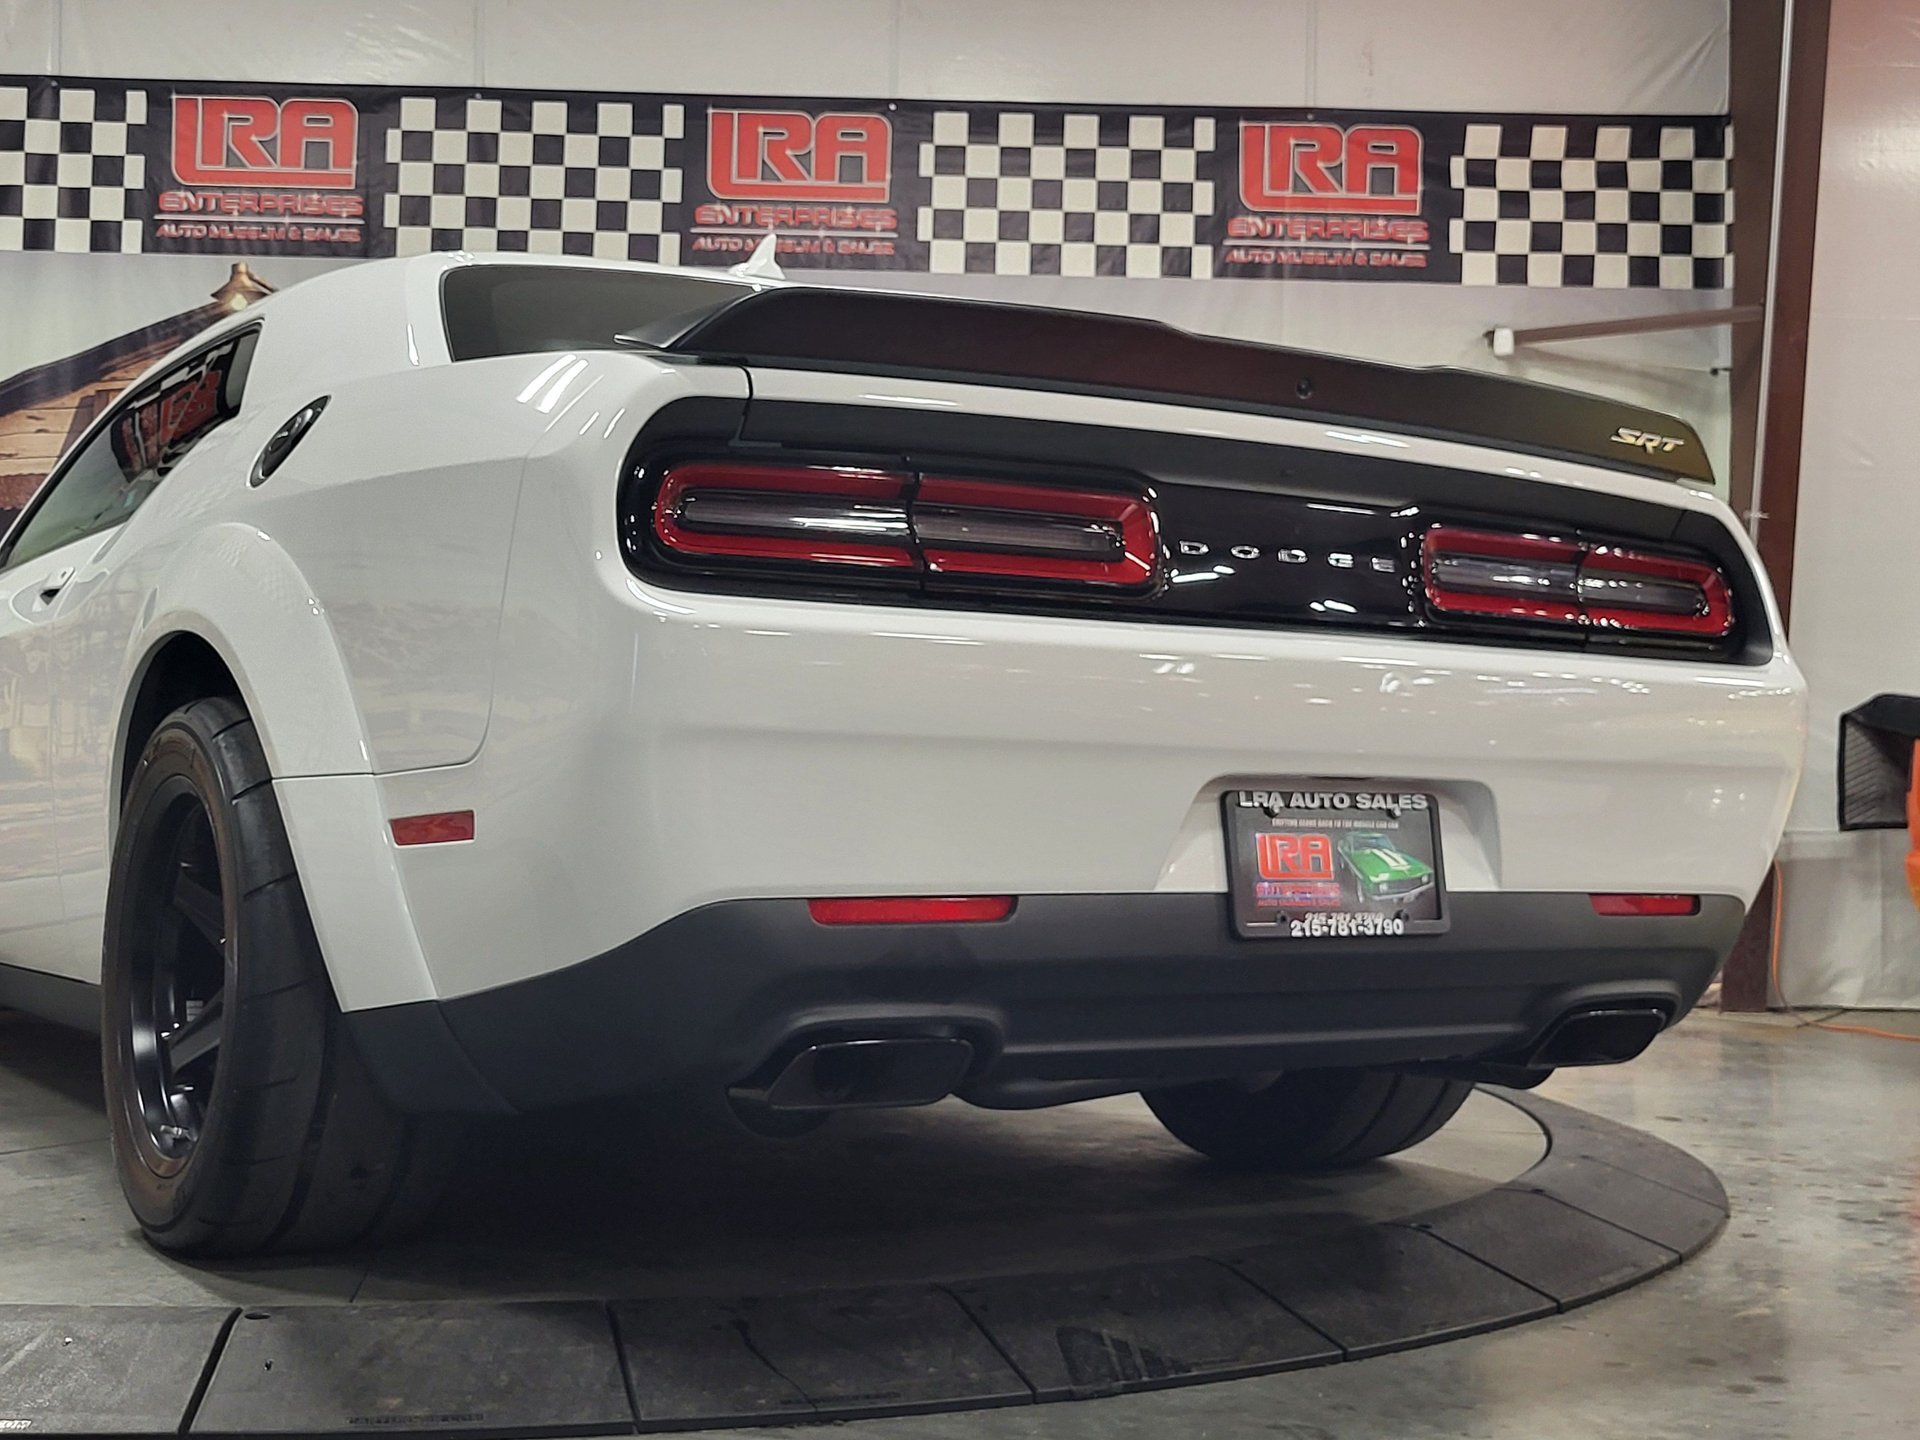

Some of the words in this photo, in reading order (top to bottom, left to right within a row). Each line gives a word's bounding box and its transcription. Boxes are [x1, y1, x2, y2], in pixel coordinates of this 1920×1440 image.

[171, 94, 359, 190] LRA
[707, 108, 893, 204] LRA
[1239, 119, 1424, 217] LRA
[158, 190, 364, 216] ENTERPRISES
[694, 204, 898, 230] ENTERPRISES
[1227, 216, 1430, 242] ENTERPRISES
[156, 224, 207, 239] AUTO
[302, 228, 362, 243] SALES
[692, 236, 743, 251] AUTO
[1225, 248, 1275, 263] AUTO
[1369, 252, 1428, 268] SALES
[1610, 427, 1684, 454] SRT
[1179, 540, 1396, 573] DODGE
[1239, 791, 1285, 808] LRA
[1289, 792, 1350, 809] AUTO
[1355, 793, 1428, 810] SALES
[1256, 833, 1335, 880] LRA
[1290, 917, 1404, 938] 215-781-3790
